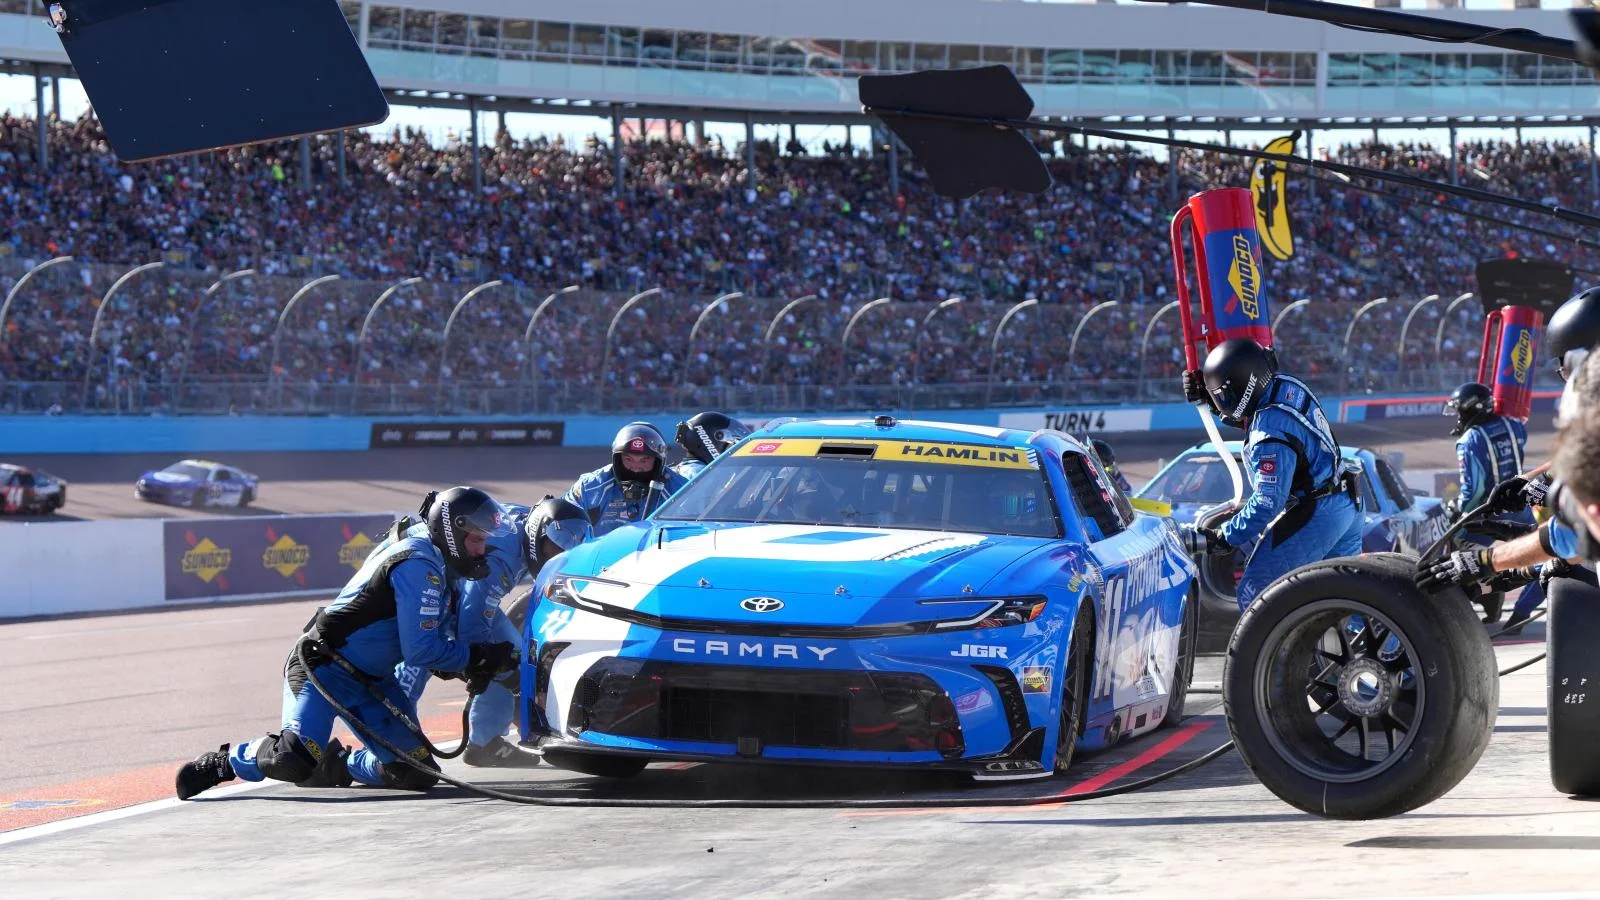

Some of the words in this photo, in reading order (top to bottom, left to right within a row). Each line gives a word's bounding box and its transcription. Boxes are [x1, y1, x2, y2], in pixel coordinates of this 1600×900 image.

[1235, 237, 1258, 316] SUNOCO
[1515, 331, 1530, 382] SUNOCO
[1045, 412, 1092, 431] TURN
[1096, 412, 1106, 430] 4
[902, 445, 1019, 463] HAMLIN
[441, 501, 460, 558] PROGRESSIVE
[184, 550, 230, 571] SUNOCO
[265, 547, 308, 567] SUNOCO
[673, 638, 838, 661] CAMRY
[950, 644, 1008, 659] JGR
